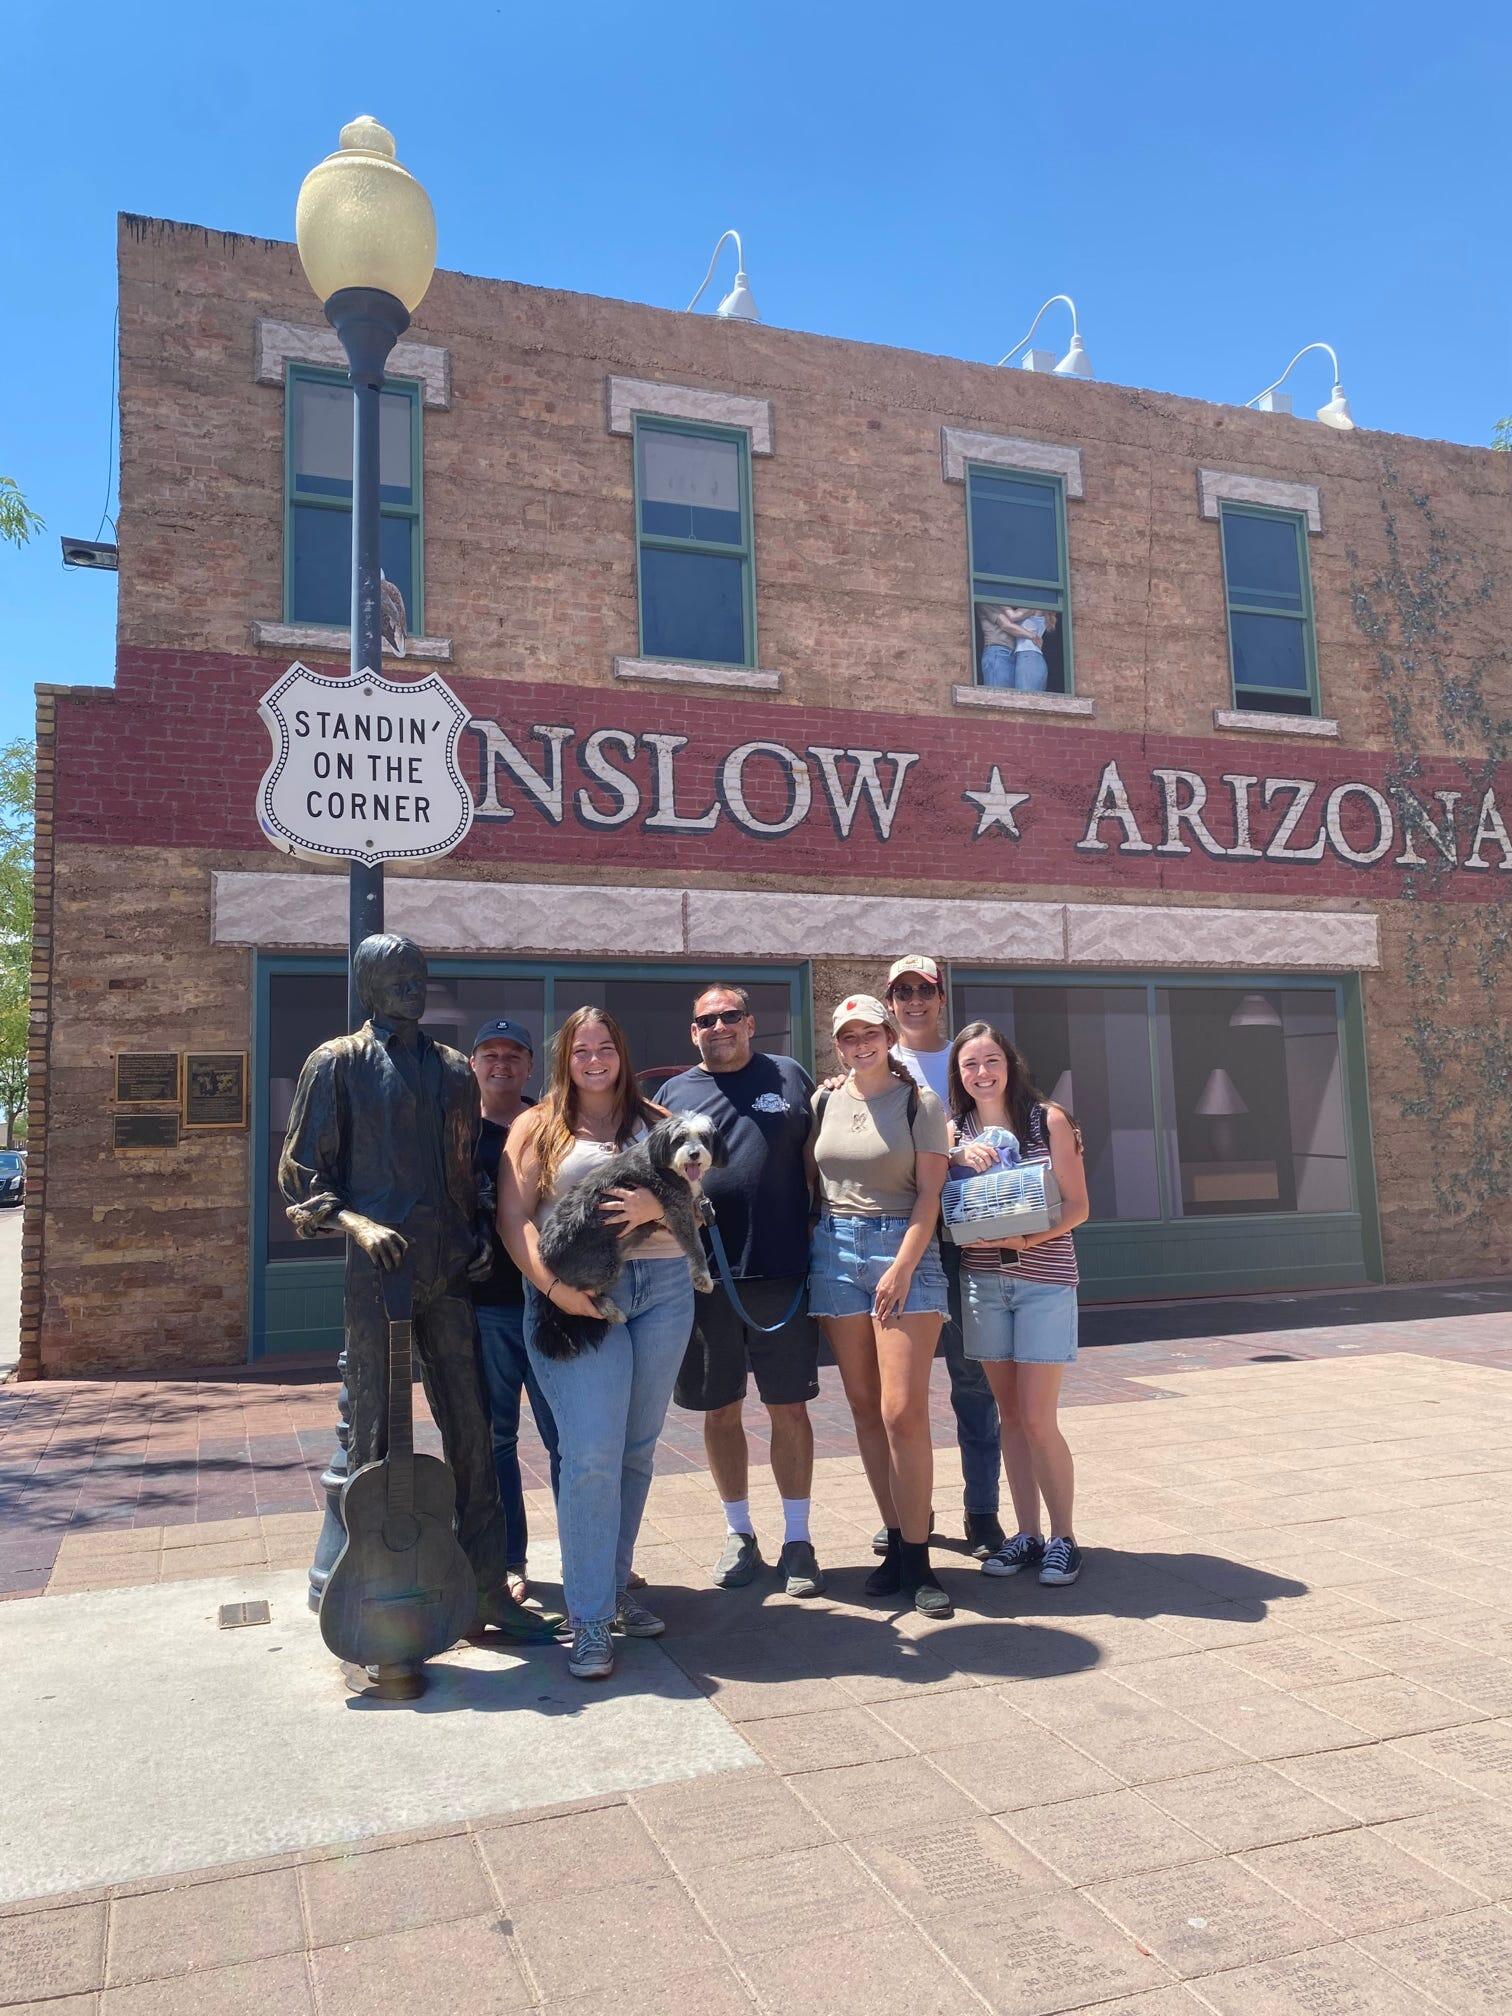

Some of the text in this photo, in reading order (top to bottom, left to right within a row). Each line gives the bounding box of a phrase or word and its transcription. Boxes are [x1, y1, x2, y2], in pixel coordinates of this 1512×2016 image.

[295, 711, 440, 745] STANDIN'
[314, 752, 422, 783] ON THE
[307, 791, 430, 823] CORNER
[471, 719, 1512, 869] NSLOW ARIZONA
